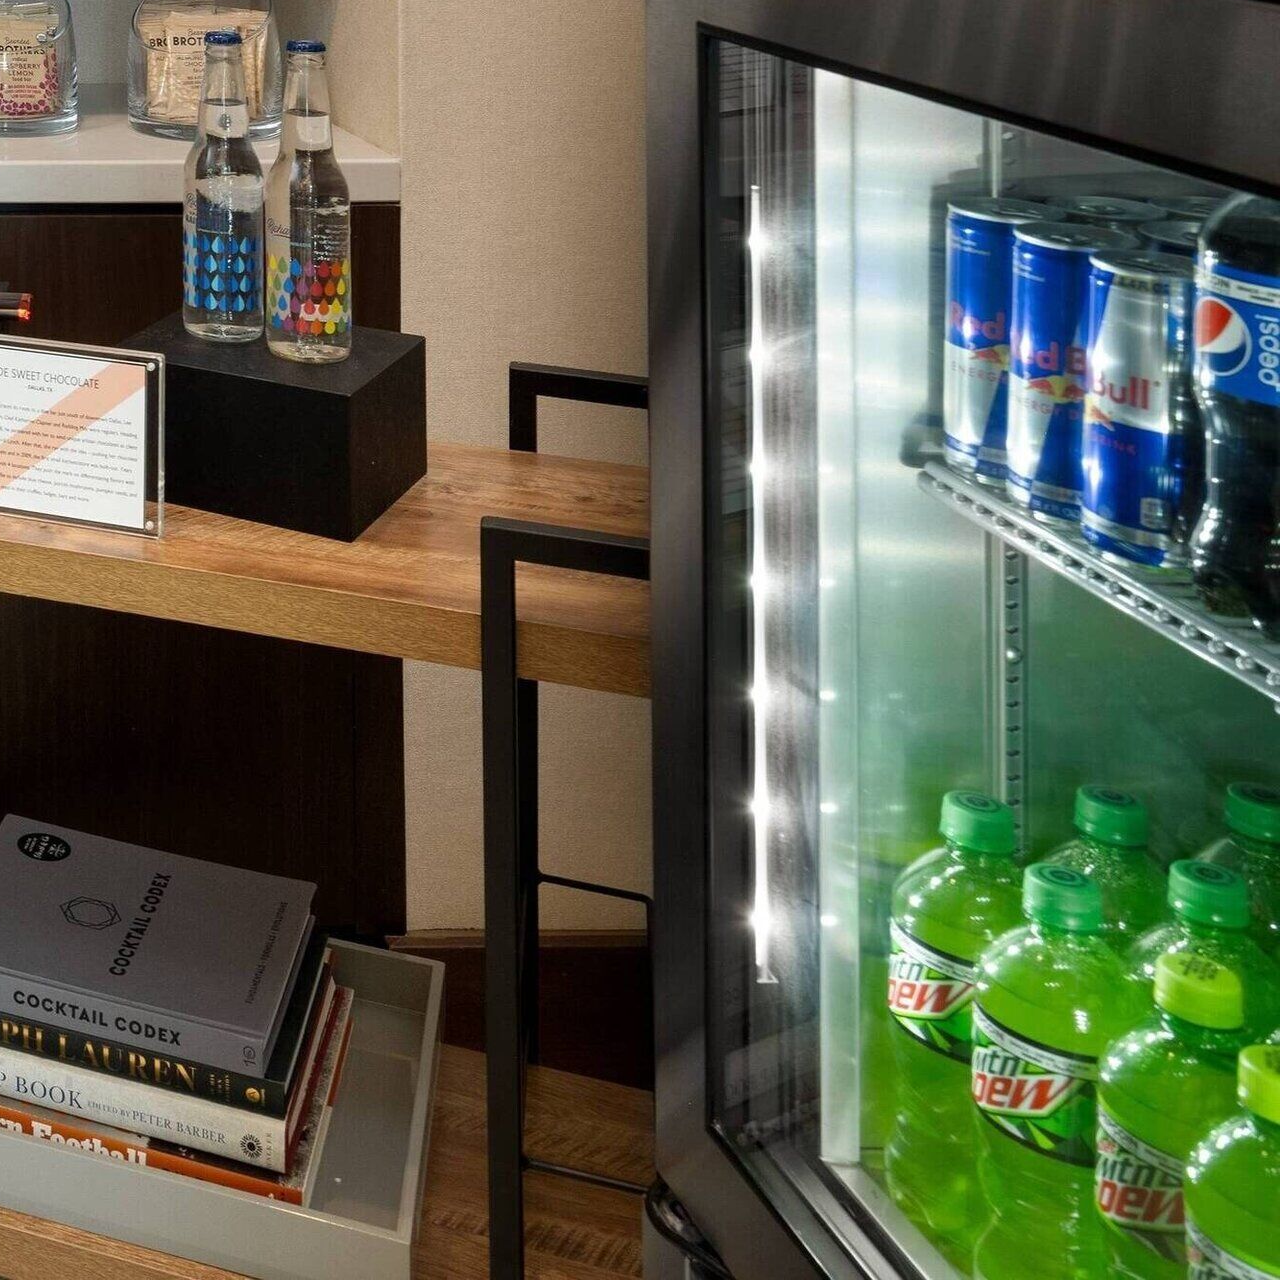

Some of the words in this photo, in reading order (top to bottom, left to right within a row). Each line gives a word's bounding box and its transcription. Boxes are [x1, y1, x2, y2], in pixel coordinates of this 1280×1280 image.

[172, 36, 206, 46] BROT
[11, 368, 41, 382] SWEET
[43, 372, 100, 390] CHOCOLATE
[108, 915, 152, 977] COCKTAIL
[141, 872, 173, 914] CODEX
[13, 990, 109, 1027] COCKTAIL
[114, 1016, 181, 1046] CODEX
[58, 1033, 197, 1092] LAUREN
[15, 1076, 84, 1110] BOOK
[87, 1100, 118, 1115] EDITED
[120, 1108, 130, 1117] BY
[131, 1109, 173, 1131] PETER
[176, 1121, 227, 1144] BARBER
[30, 1120, 148, 1167] Football
